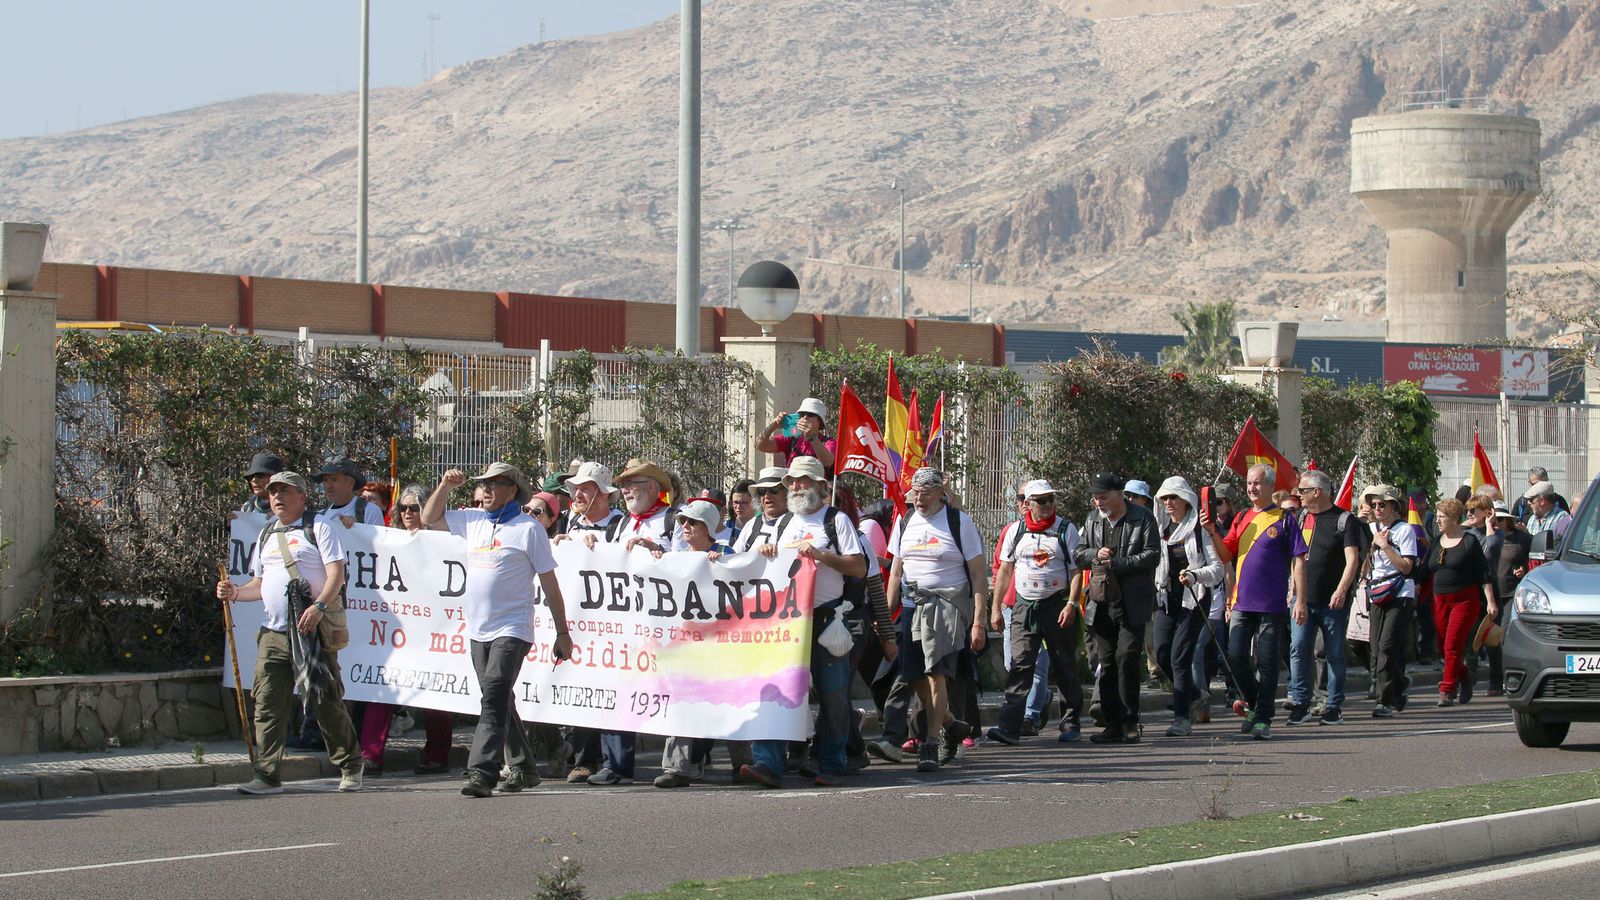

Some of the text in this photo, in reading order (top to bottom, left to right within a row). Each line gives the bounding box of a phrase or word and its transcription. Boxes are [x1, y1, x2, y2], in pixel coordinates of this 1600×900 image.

[1311, 356, 1339, 374] S.L.
[1408, 361, 1480, 372] ORAN GHAZAOUET
[347, 597, 432, 618] nuestras
[567, 619, 624, 636] rompan
[717, 626, 800, 643] memoria.
[369, 619, 407, 648] No
[429, 622, 467, 654] má
[350, 663, 470, 696] CARRETERA
[552, 684, 617, 710] MUERTE
[630, 690, 670, 718] 1937
